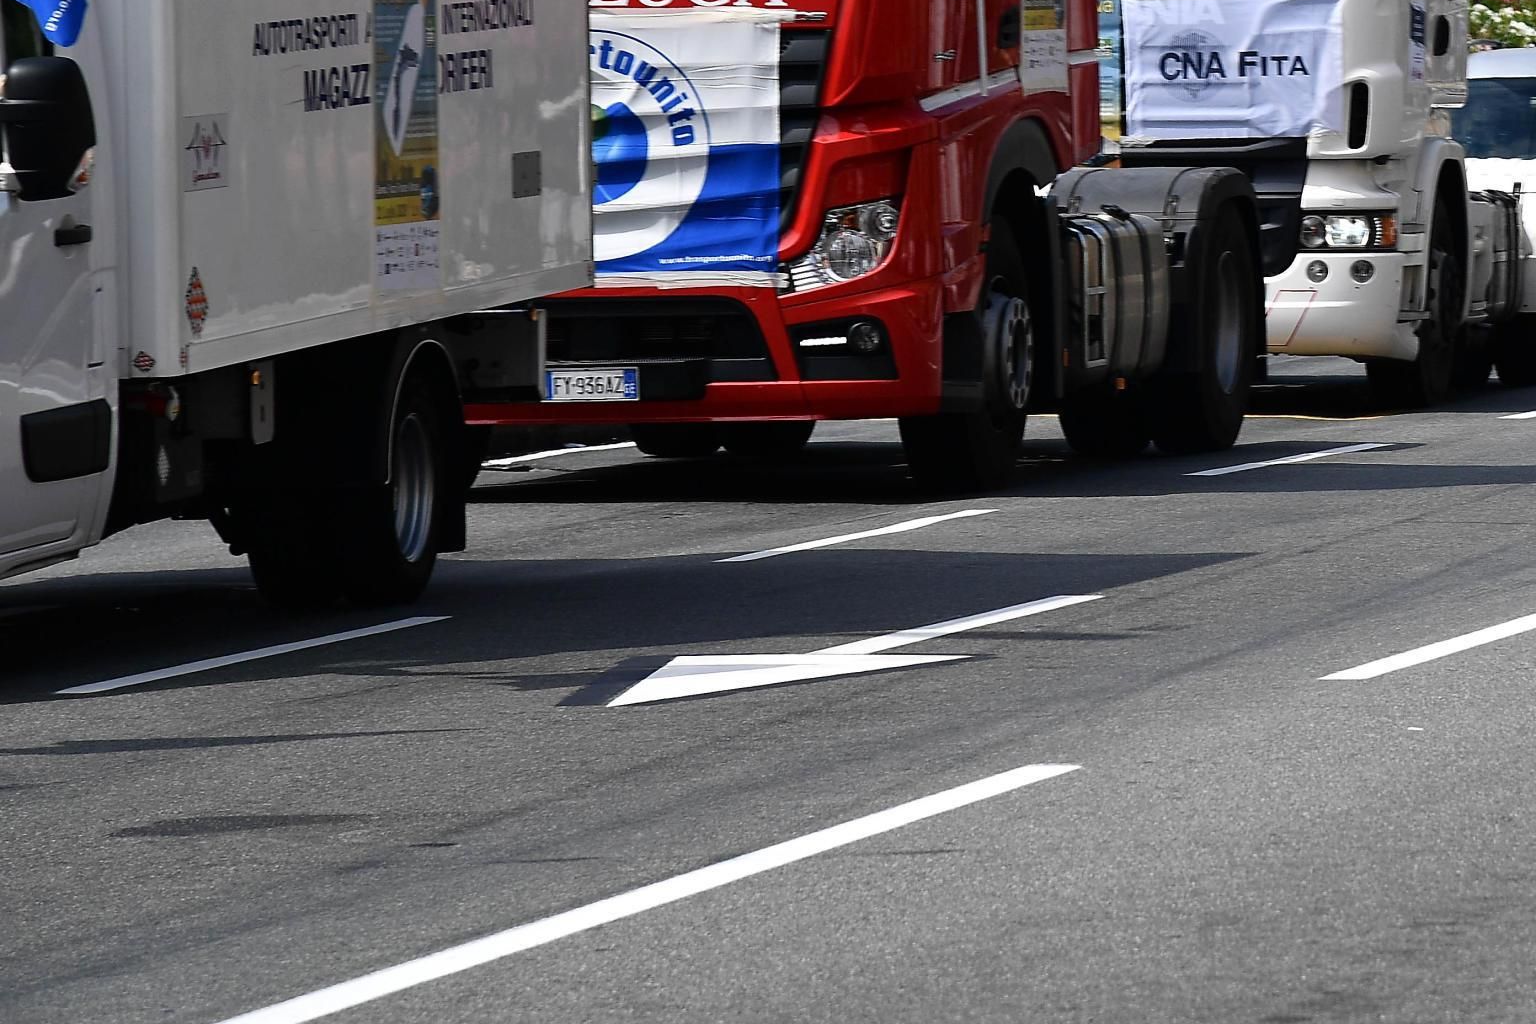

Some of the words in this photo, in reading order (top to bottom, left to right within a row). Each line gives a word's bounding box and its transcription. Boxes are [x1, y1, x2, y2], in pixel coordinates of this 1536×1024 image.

[251, 13, 359, 57] AUTOTRASPORTI
[303, 62, 372, 113] MAGAZZ
[1159, 51, 1227, 81] CNA
